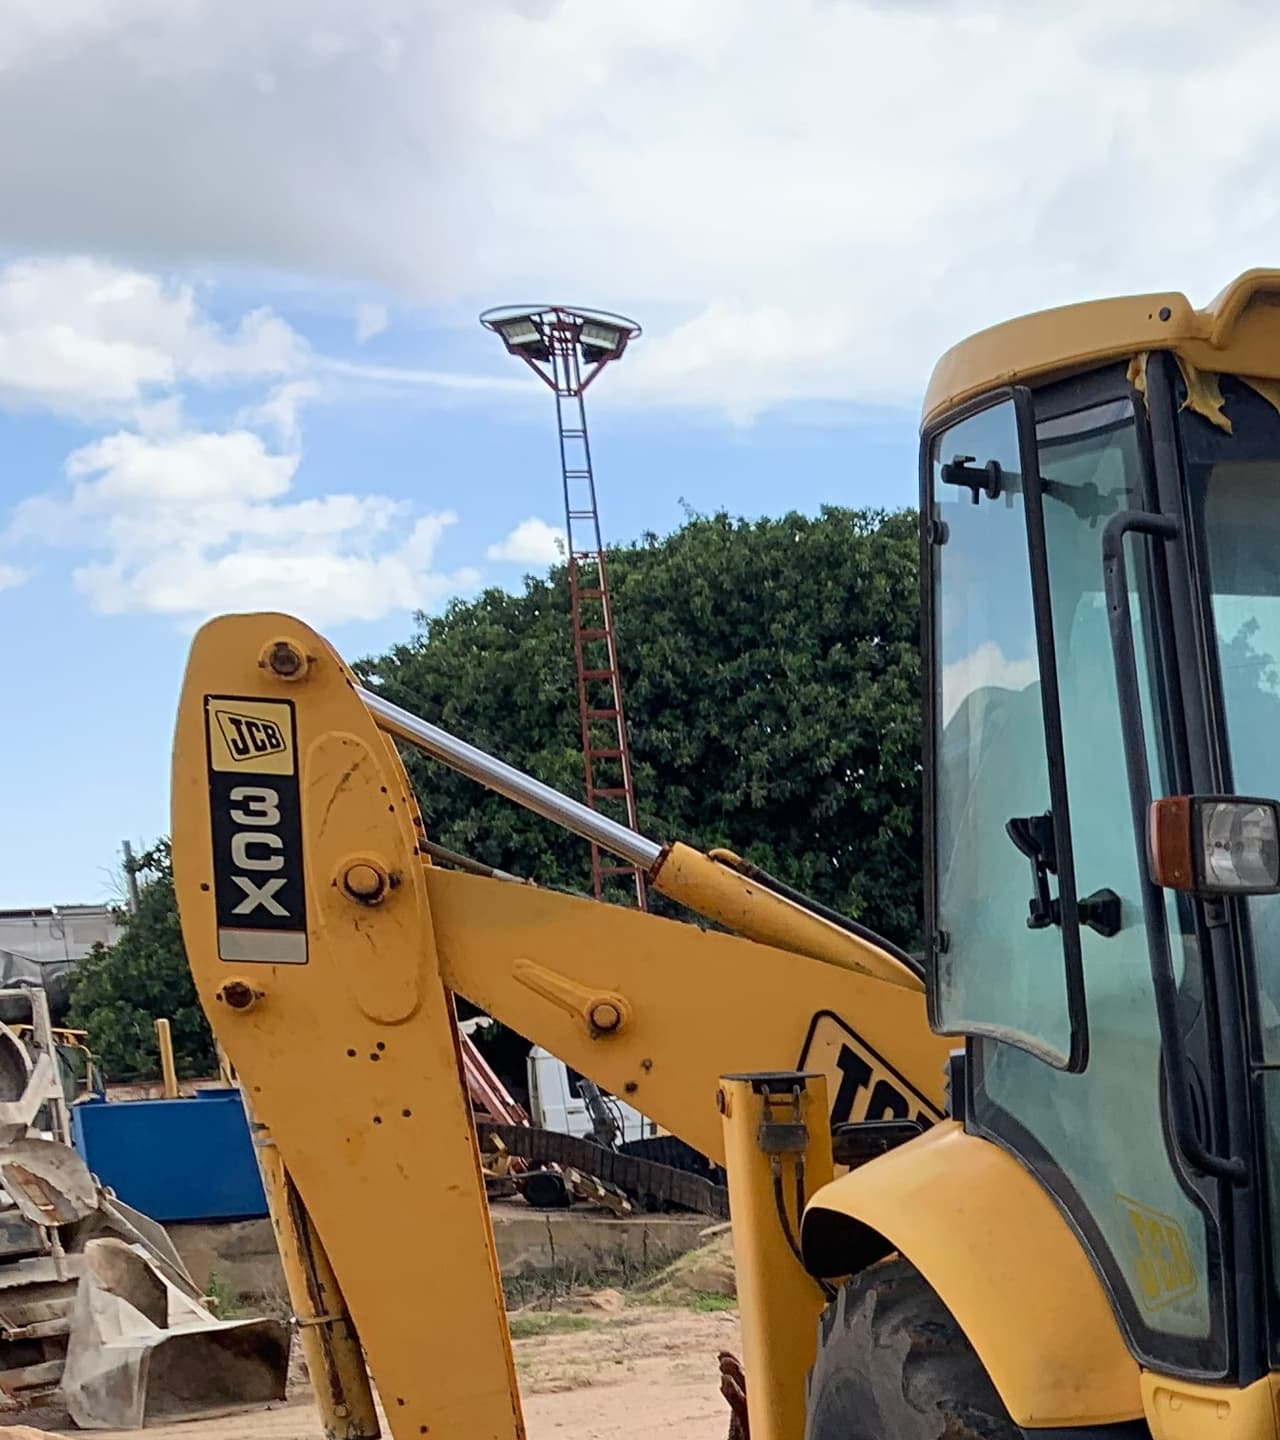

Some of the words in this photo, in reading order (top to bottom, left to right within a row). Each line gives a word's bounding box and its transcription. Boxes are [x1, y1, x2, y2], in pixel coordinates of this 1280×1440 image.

[228, 716, 281, 756] JCB
[229, 786, 291, 917] 3CX
[1127, 1209, 1194, 1298] JCB
